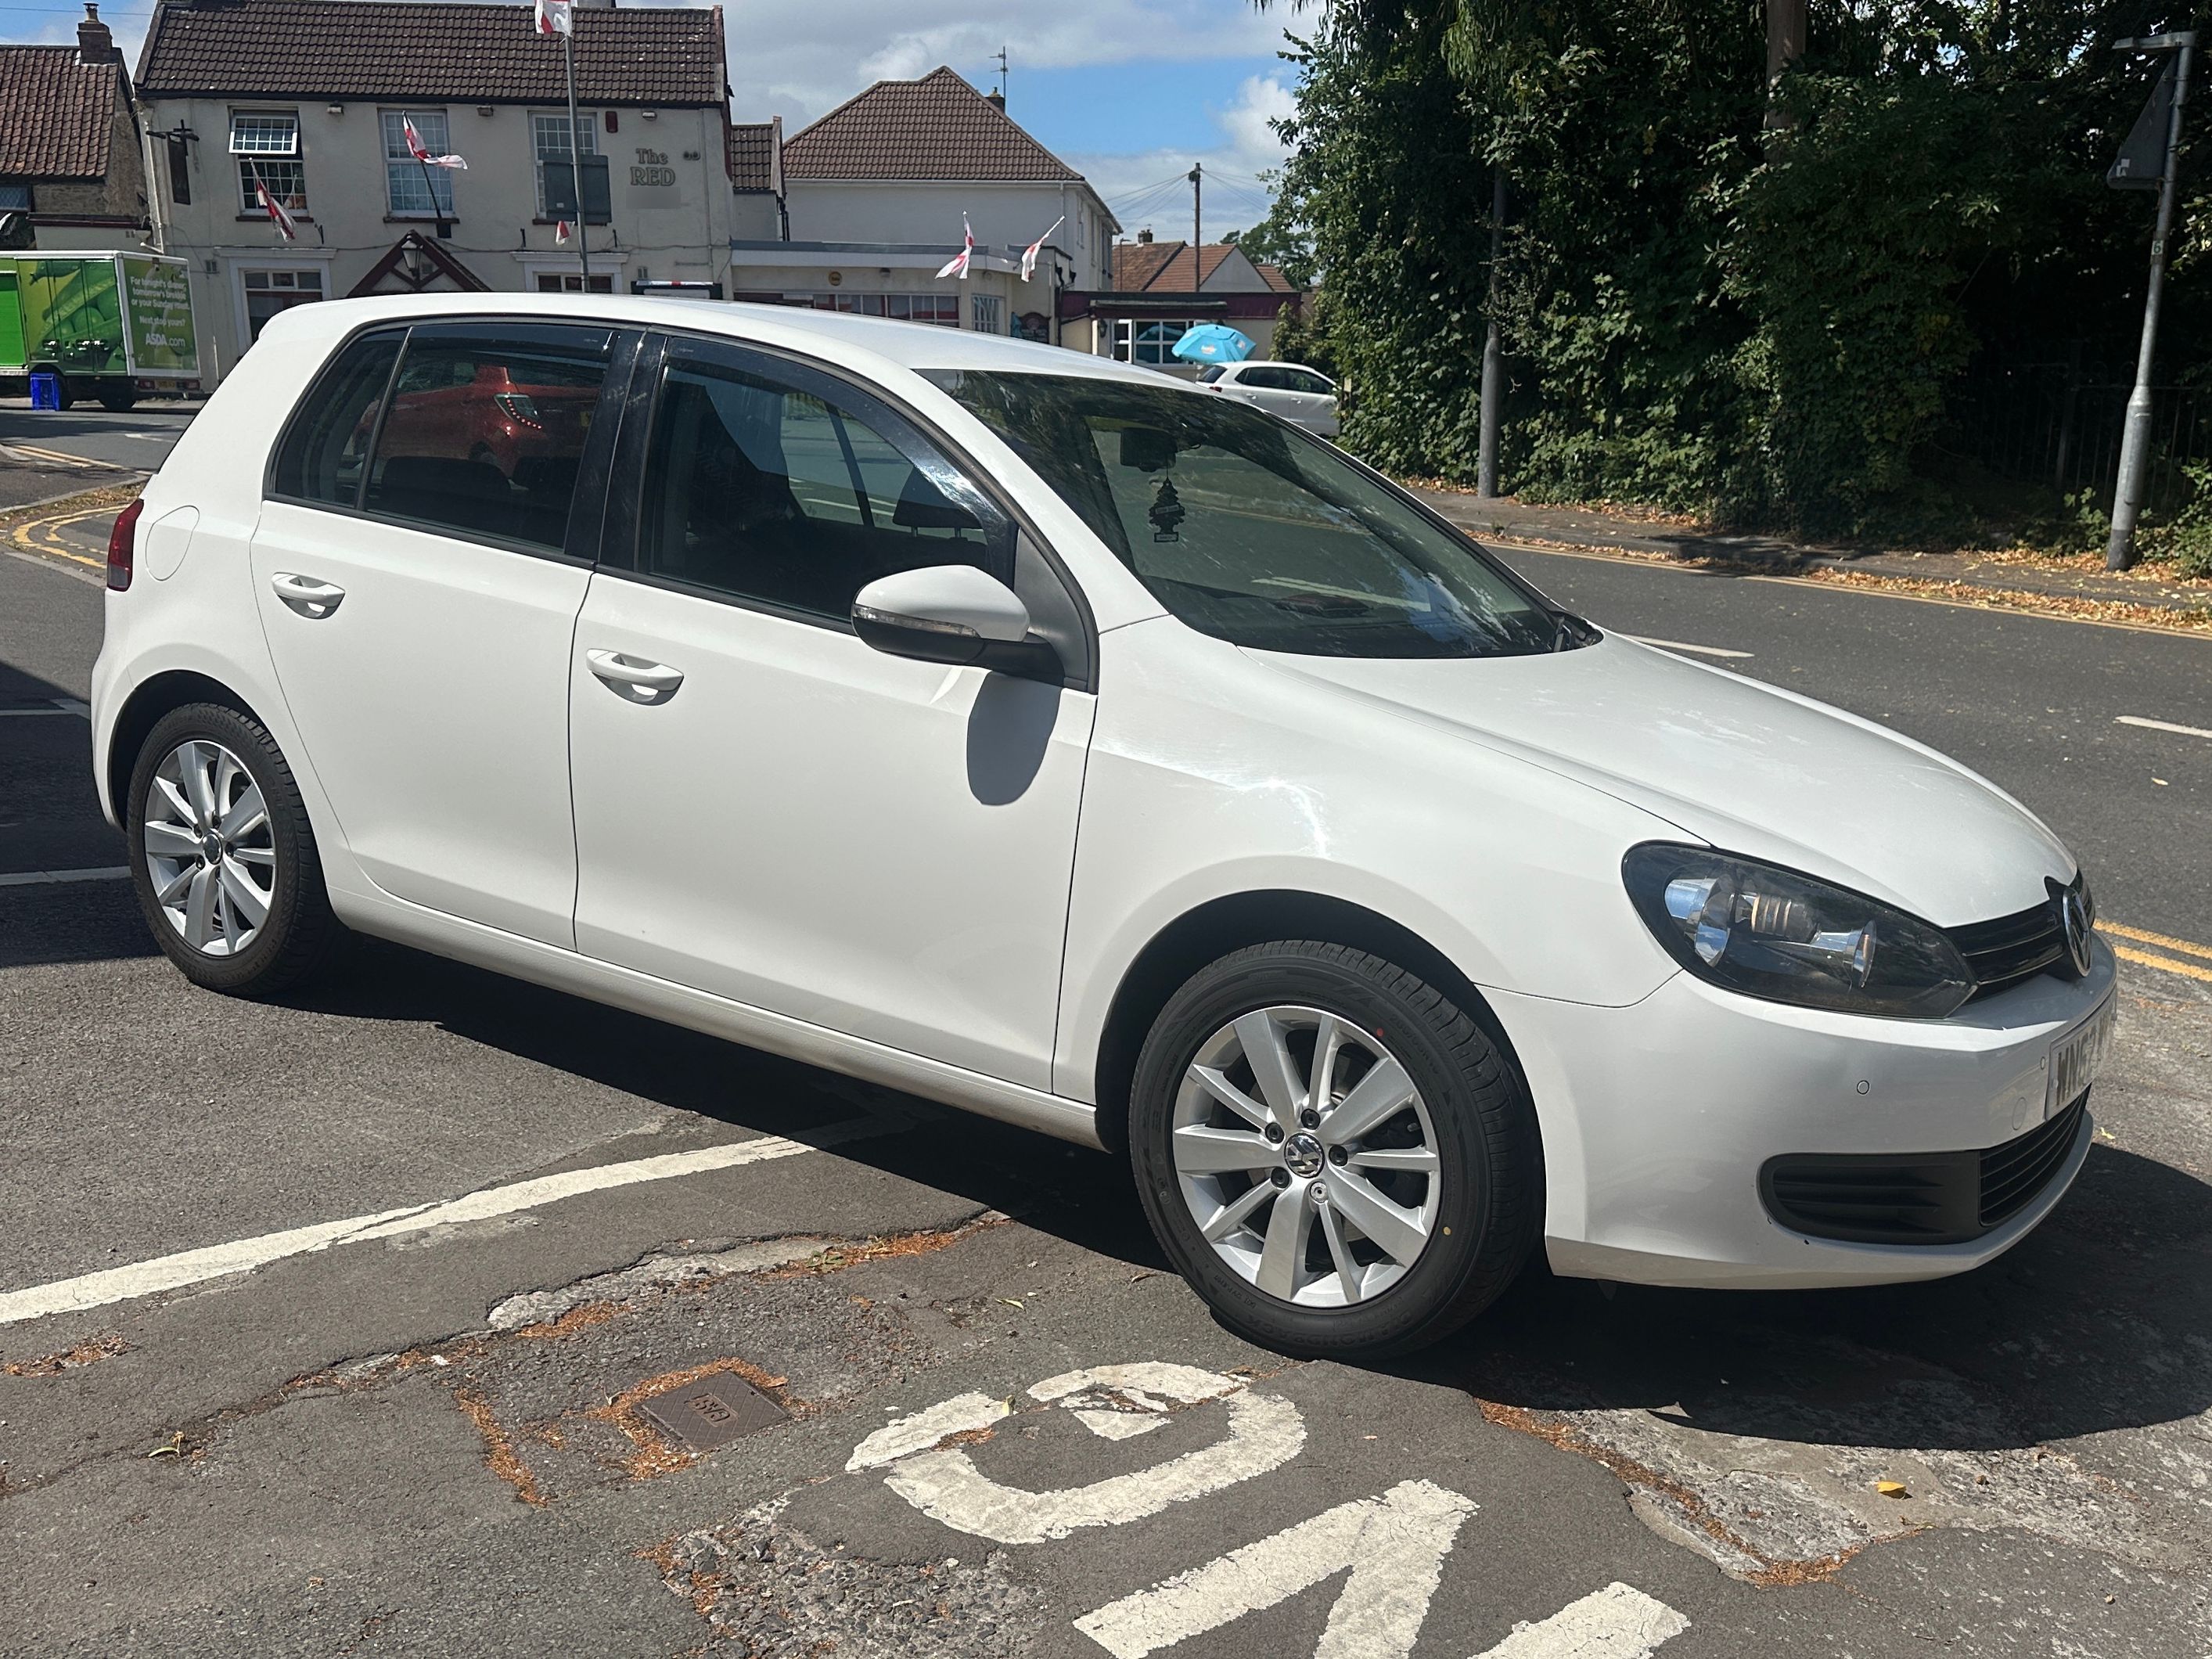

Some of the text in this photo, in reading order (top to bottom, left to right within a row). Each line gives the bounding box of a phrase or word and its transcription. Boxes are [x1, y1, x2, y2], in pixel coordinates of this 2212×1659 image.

[635, 148, 669, 165] The
[630, 166, 676, 186] RED
[130, 276, 140, 285] For
[138, 299, 152, 308] your
[139, 315, 153, 325] Next
[153, 317, 167, 327] stop
[145, 333, 186, 347] ASDA.com
